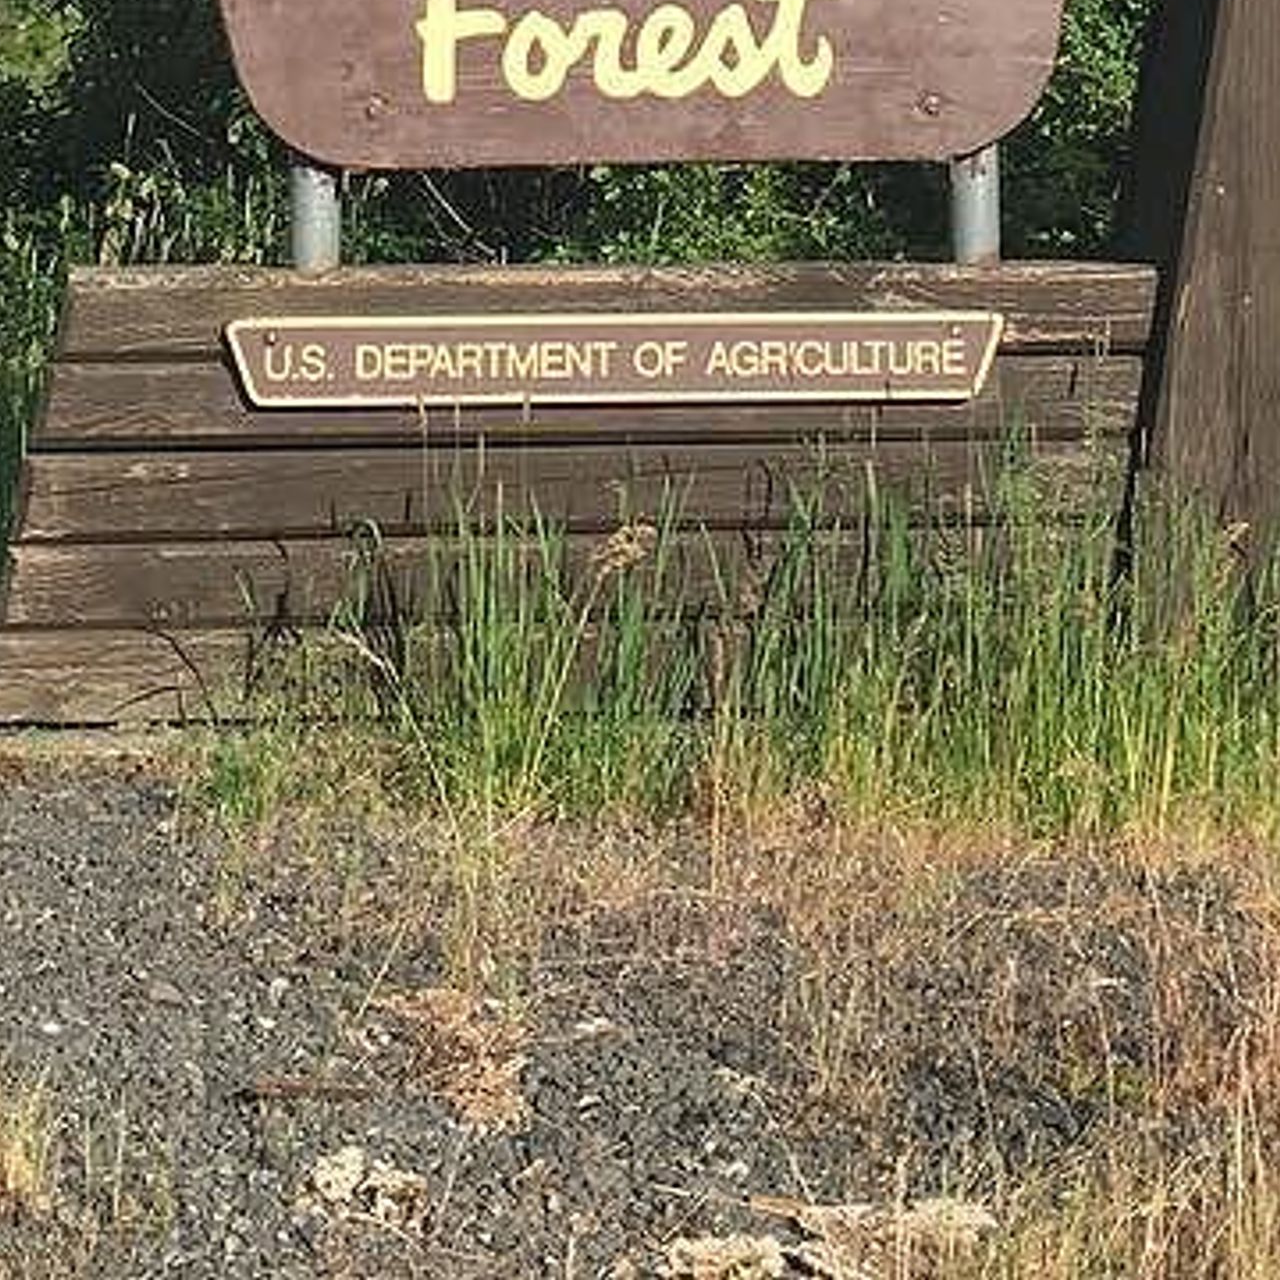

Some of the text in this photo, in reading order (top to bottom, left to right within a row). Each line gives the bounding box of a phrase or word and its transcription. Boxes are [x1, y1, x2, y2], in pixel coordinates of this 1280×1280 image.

[264, 337, 967, 382] U.S. DEPARTMENT OF AGRICULTURE
